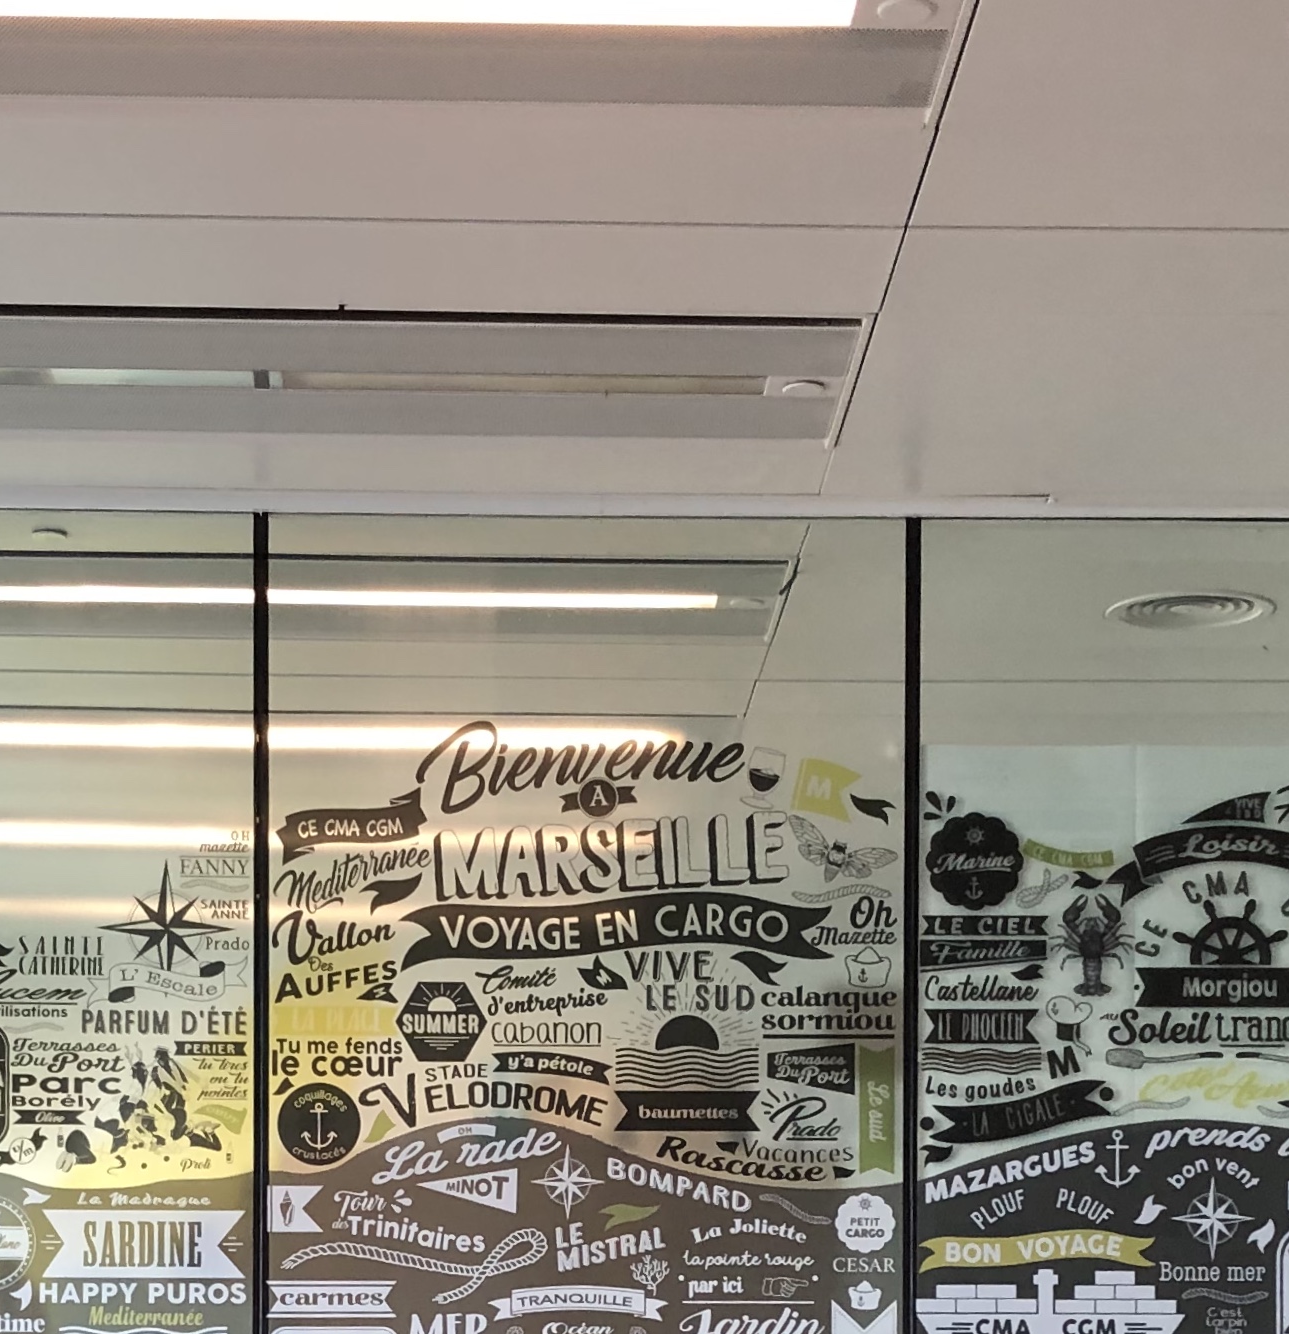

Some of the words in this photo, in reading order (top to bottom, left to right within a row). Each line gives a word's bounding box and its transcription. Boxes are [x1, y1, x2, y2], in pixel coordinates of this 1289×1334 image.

[415, 720, 746, 814] Bienvenue
[297, 819, 317, 838] CE
[325, 819, 359, 837] CMA
[367, 818, 404, 837] CGM
[179, 858, 250, 876] FANNY
[433, 810, 790, 902] MARSEILLE
[933, 853, 1015, 874] Marine
[850, 895, 897, 929] Oh
[272, 910, 395, 966] Vallon
[439, 914, 581, 951] VOYAGE
[595, 908, 640, 946] EN
[654, 902, 790, 943] CARGO
[811, 925, 897, 946] Mazette
[934, 918, 964, 934] LE
[977, 917, 1036, 934] CIEL
[205, 937, 250, 950] Prado
[624, 951, 714, 982] VIVE
[275, 961, 397, 1003] AUFFES
[475, 966, 557, 995] Comité
[924, 975, 1039, 1002] Castellane
[1183, 976, 1278, 1001] Morgiou
[646, 985, 676, 1011] LE
[696, 985, 755, 1012] SUD
[761, 989, 898, 1013] calanque
[402, 1013, 479, 1035] SUMMER
[492, 1022, 601, 1043] cabanon
[762, 1010, 896, 1031] sormiou
[183, 1044, 236, 1055] PERIER
[276, 1038, 300, 1054] Tu
[307, 1041, 339, 1054] me
[346, 1038, 402, 1054] fends
[12, 1074, 121, 1094] Parc
[425, 1063, 488, 1082] STADE
[359, 1073, 608, 1128] VELODROME
[925, 1075, 958, 1095] Les
[966, 1077, 1036, 1102] goudes
[638, 1105, 739, 1120] baumettes
[768, 1096, 841, 1141] Prado
[742, 1138, 854, 1163] Vacances
[1144, 1126, 1272, 1158] prends
[372, 1140, 449, 1185] La
[456, 1128, 561, 1168] rade
[657, 1136, 827, 1181] Rascasse
[606, 1157, 752, 1213] BOMPARD
[925, 1141, 1095, 1204] MAZARGUES
[1166, 1157, 1210, 1191] bon
[1214, 1157, 1261, 1190] vent
[445, 1176, 509, 1200] MINOT
[970, 1189, 1025, 1230] PLOUF
[1056, 1187, 1115, 1225] PLOUF
[347, 1215, 485, 1253] Trinitaires
[690, 1225, 722, 1244] La
[729, 1218, 807, 1244] Joliette
[844, 1228, 885, 1238] CARGO
[850, 1217, 880, 1226] PETIT
[83, 1221, 202, 1268] SARDINE
[555, 1222, 583, 1248] LE
[557, 1227, 666, 1272] MISTRAL
[945, 1241, 1001, 1263] BON
[1017, 1235, 1123, 1259] VOYAGE
[832, 1257, 896, 1273] CESAR
[1159, 1262, 1221, 1283] Bonne
[1226, 1265, 1266, 1282] mer
[39, 1283, 138, 1305] HAPPY
[148, 1282, 247, 1305] PUROS
[279, 1291, 385, 1307] carmes
[515, 1291, 633, 1309] TRANQUILLE
